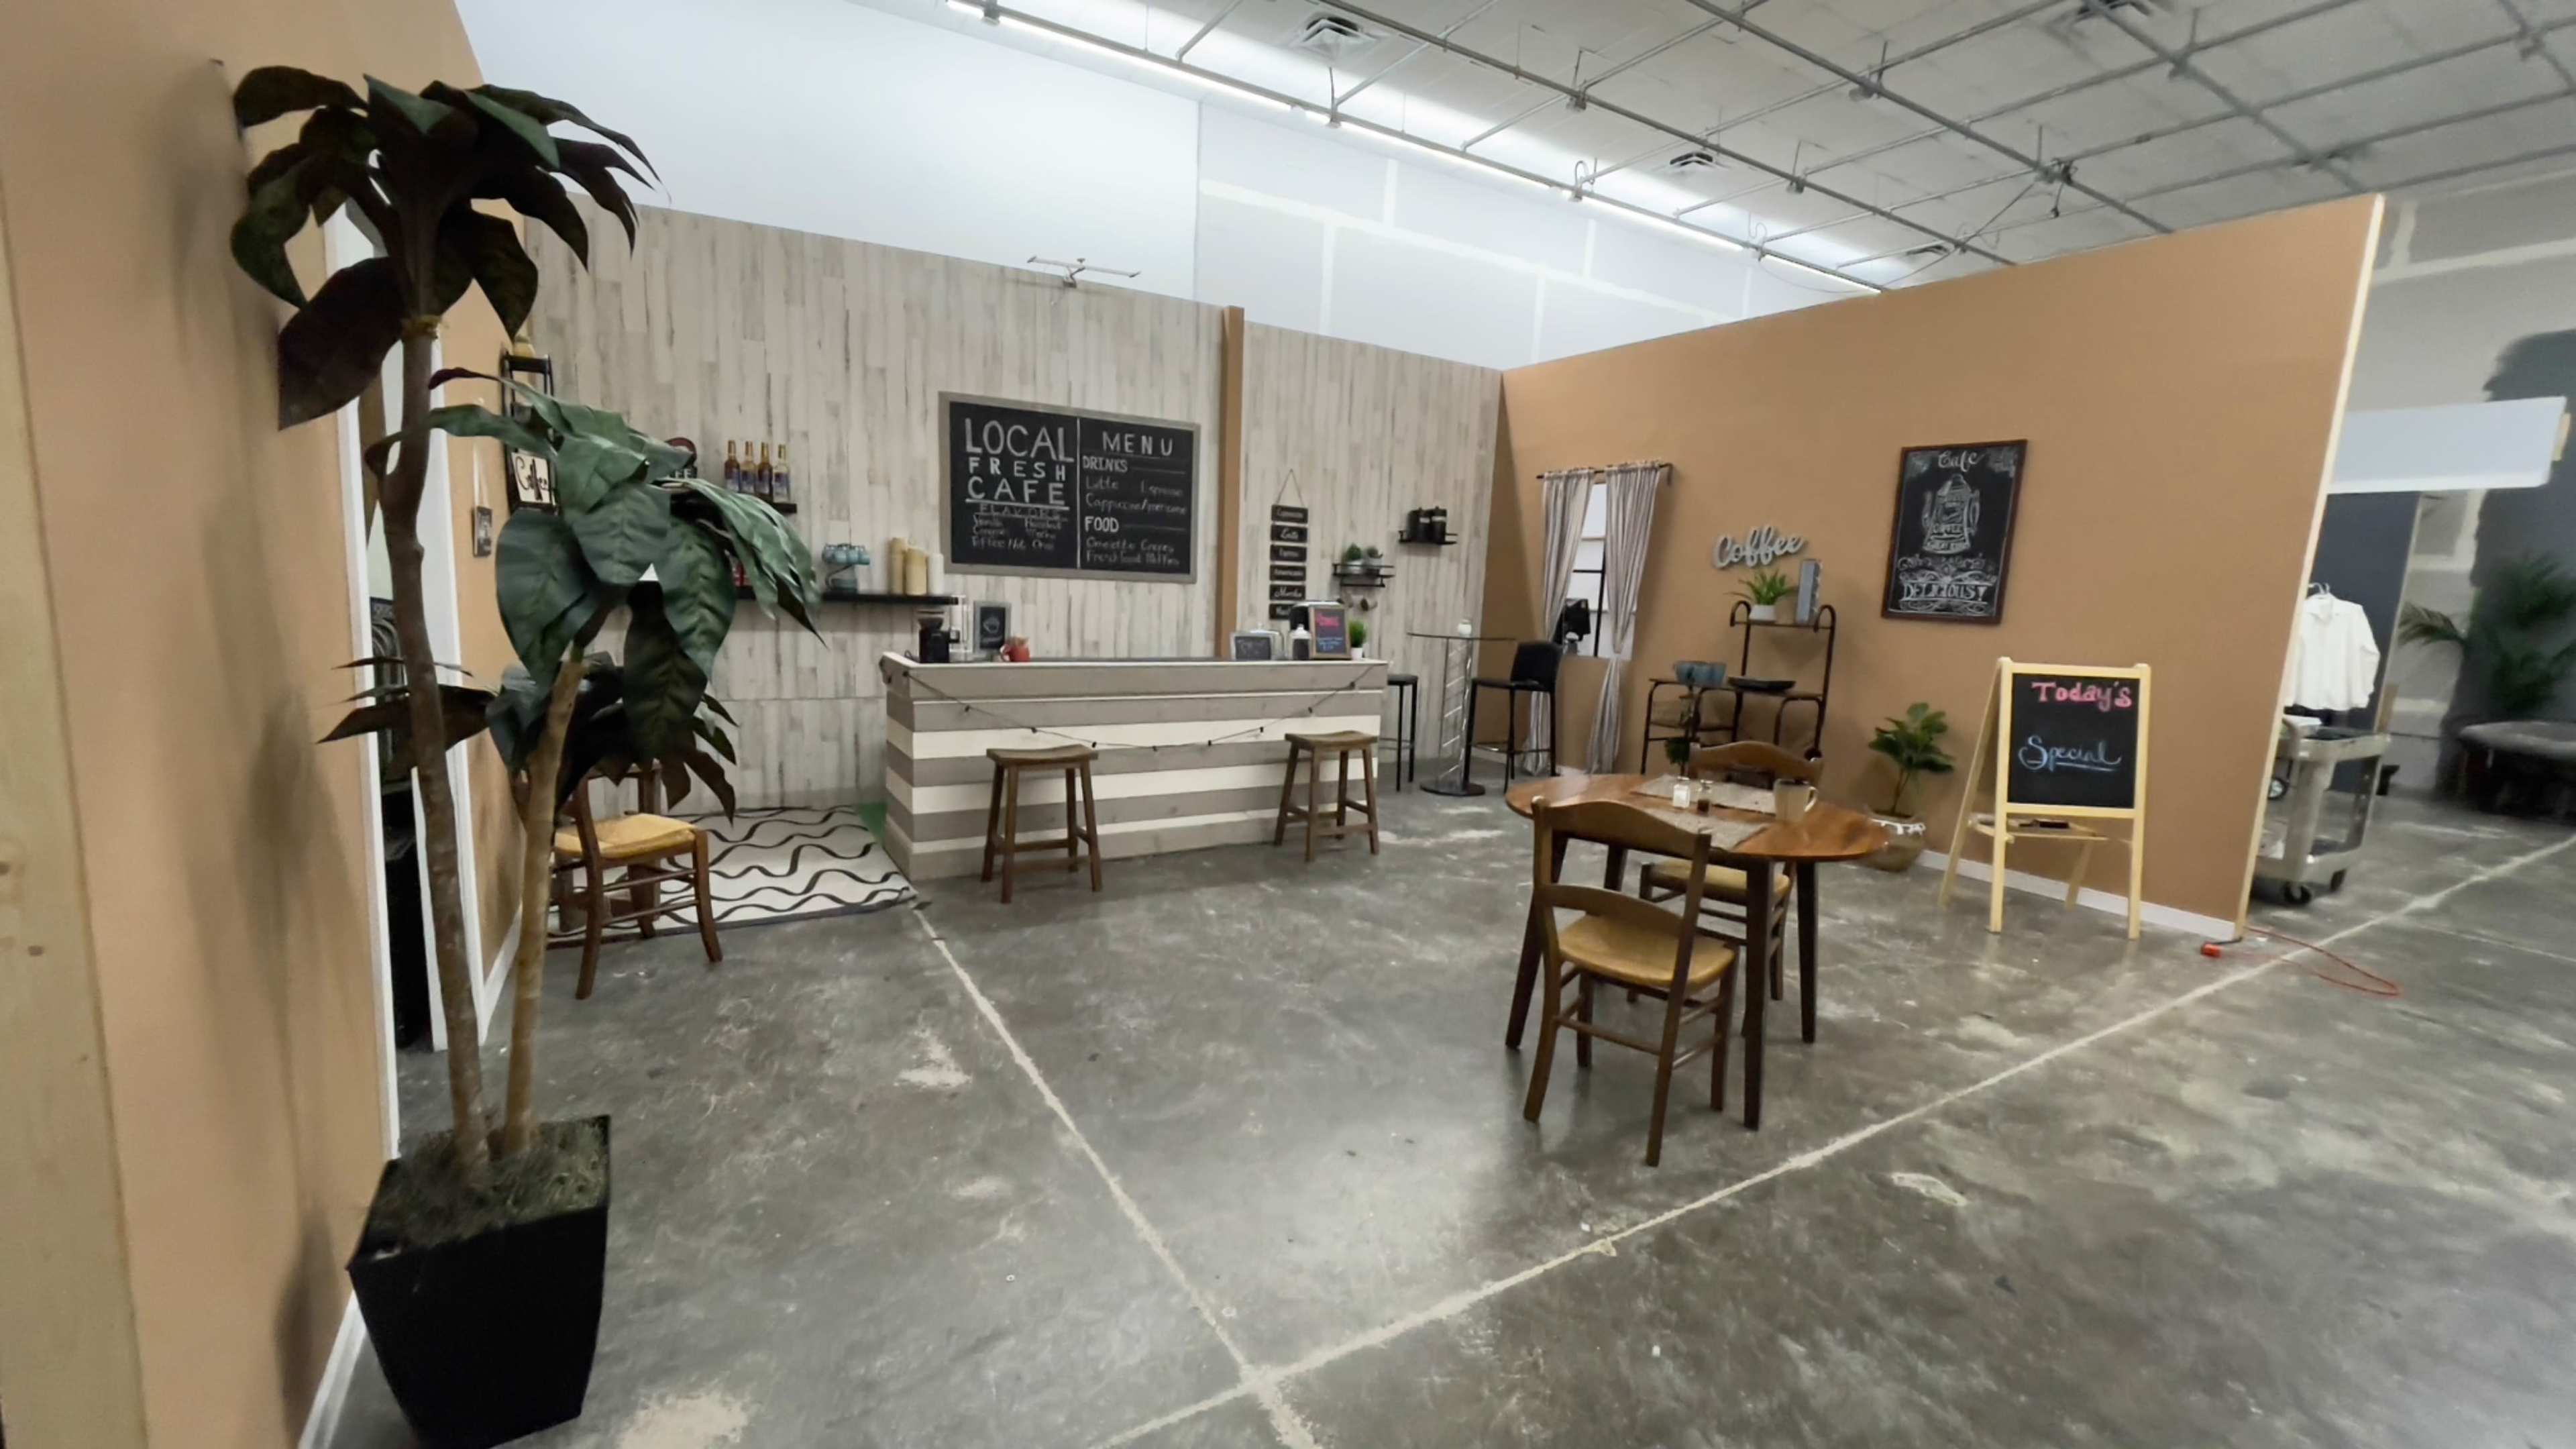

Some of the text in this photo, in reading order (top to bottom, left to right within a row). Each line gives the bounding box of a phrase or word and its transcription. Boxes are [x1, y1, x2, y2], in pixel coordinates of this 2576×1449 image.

[965, 418, 1075, 462] LOCAL
[1102, 431, 1173, 456] MENU
[969, 457, 1065, 481] FRESH
[1082, 455, 1128, 473] DRINKS
[968, 476, 1065, 505] CAFE
[1084, 516, 1120, 533] FOOD
[1715, 526, 1805, 568] Coffee
[2031, 681, 2133, 712] Today's
[2018, 735, 2122, 771] Special
